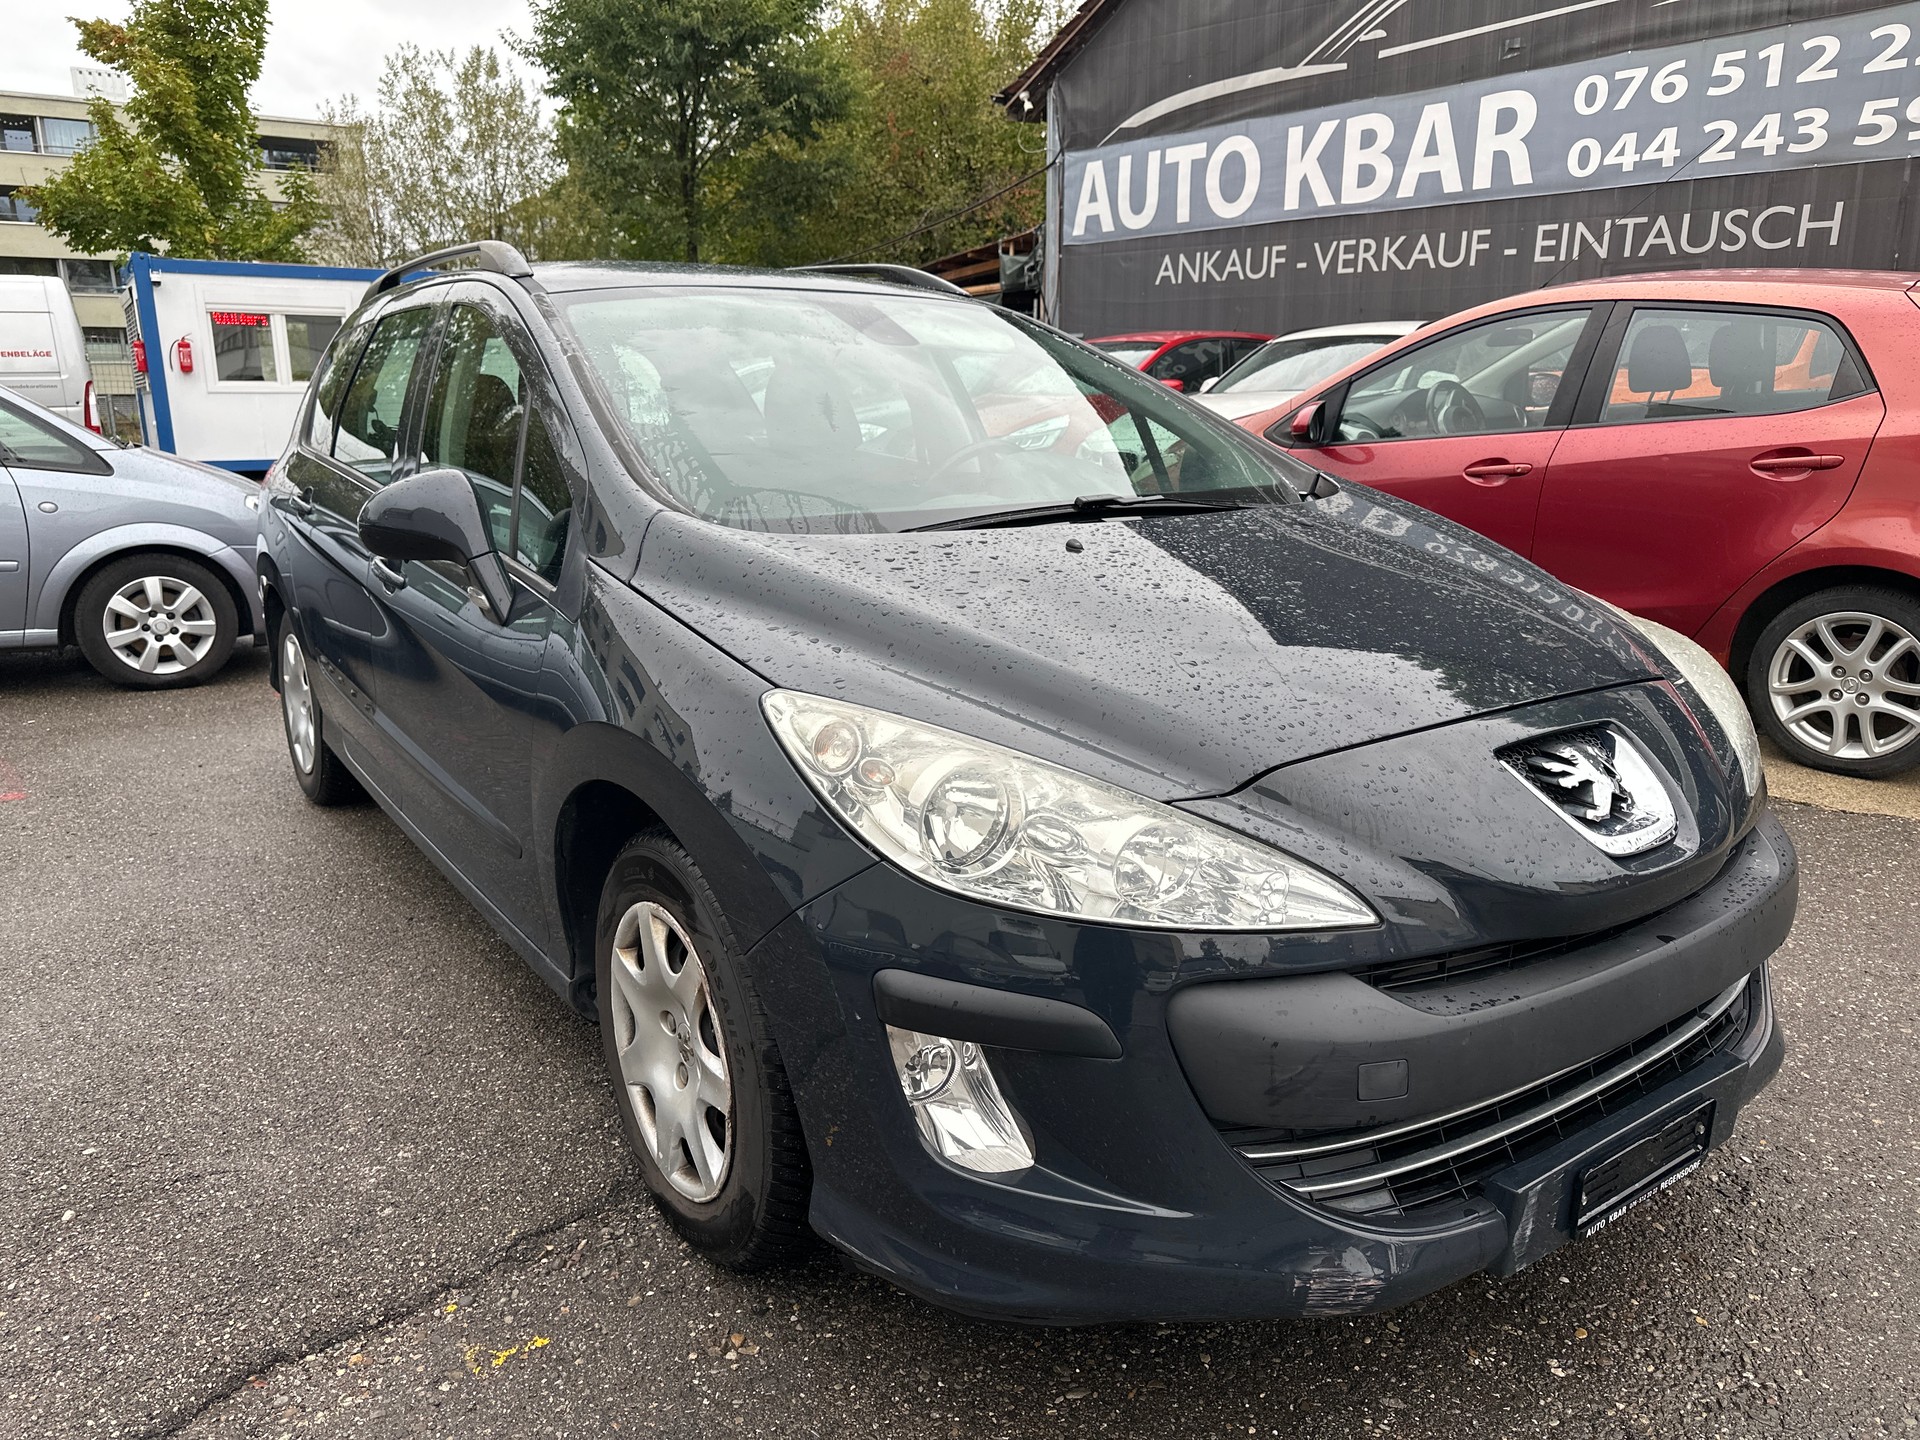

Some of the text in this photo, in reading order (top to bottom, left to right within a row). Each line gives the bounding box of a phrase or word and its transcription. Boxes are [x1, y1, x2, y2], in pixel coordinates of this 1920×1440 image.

[1573, 23, 1920, 116] 076 512 2
[1072, 90, 1538, 236] AUTO KBAR
[1566, 126, 1681, 178] 044
[1698, 107, 1830, 164] 243
[1155, 245, 1287, 286] ANKAUF
[1313, 229, 1492, 275] VERKAUF
[1533, 201, 1845, 263] EINTAUSCH
[1586, 1219, 1606, 1238] AUTO
[1608, 1206, 1627, 1223] KBAR
[1660, 1159, 1701, 1191] REGENSDORF
